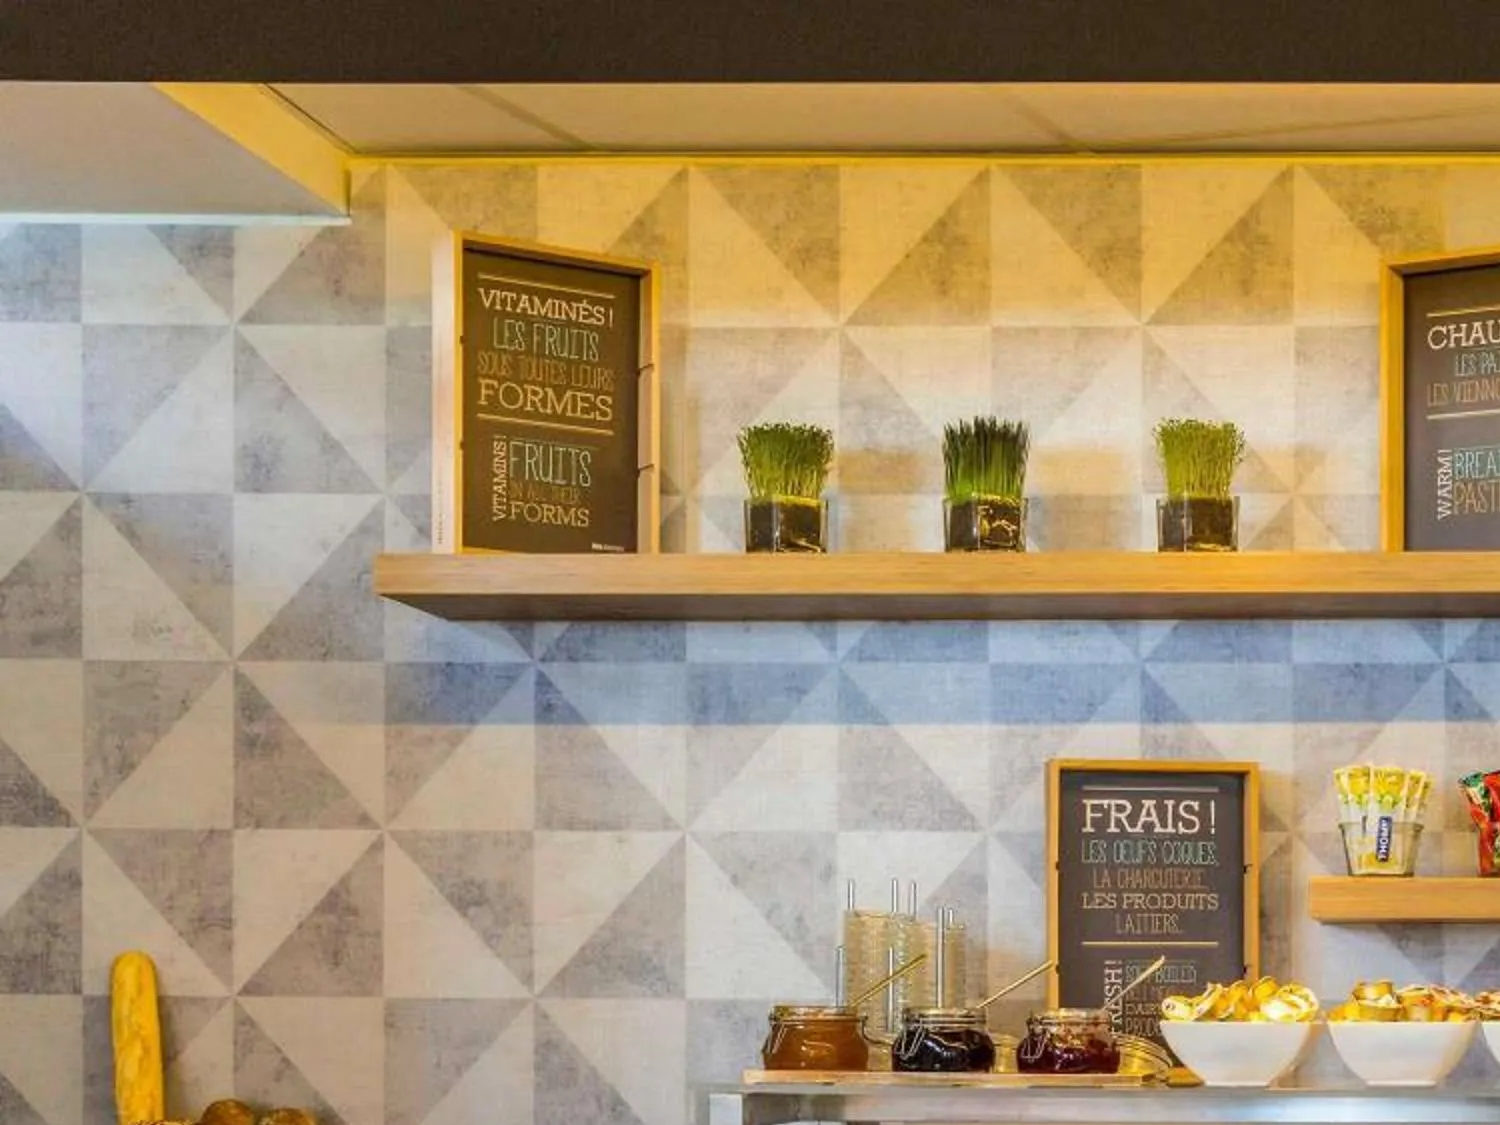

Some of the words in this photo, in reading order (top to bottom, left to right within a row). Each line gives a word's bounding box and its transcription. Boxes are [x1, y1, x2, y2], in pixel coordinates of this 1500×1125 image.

[493, 317, 525, 351] LES
[533, 321, 599, 362] FRUITS
[1455, 353, 1476, 377] LES
[478, 378, 613, 421] FORMES
[509, 441, 592, 488] FRUITS
[509, 502, 590, 528] FORMS
[1082, 839, 1108, 865] LES
[1093, 867, 1111, 889] LA
[1082, 892, 1117, 910] LES
[1122, 892, 1219, 910] PRODUITS
